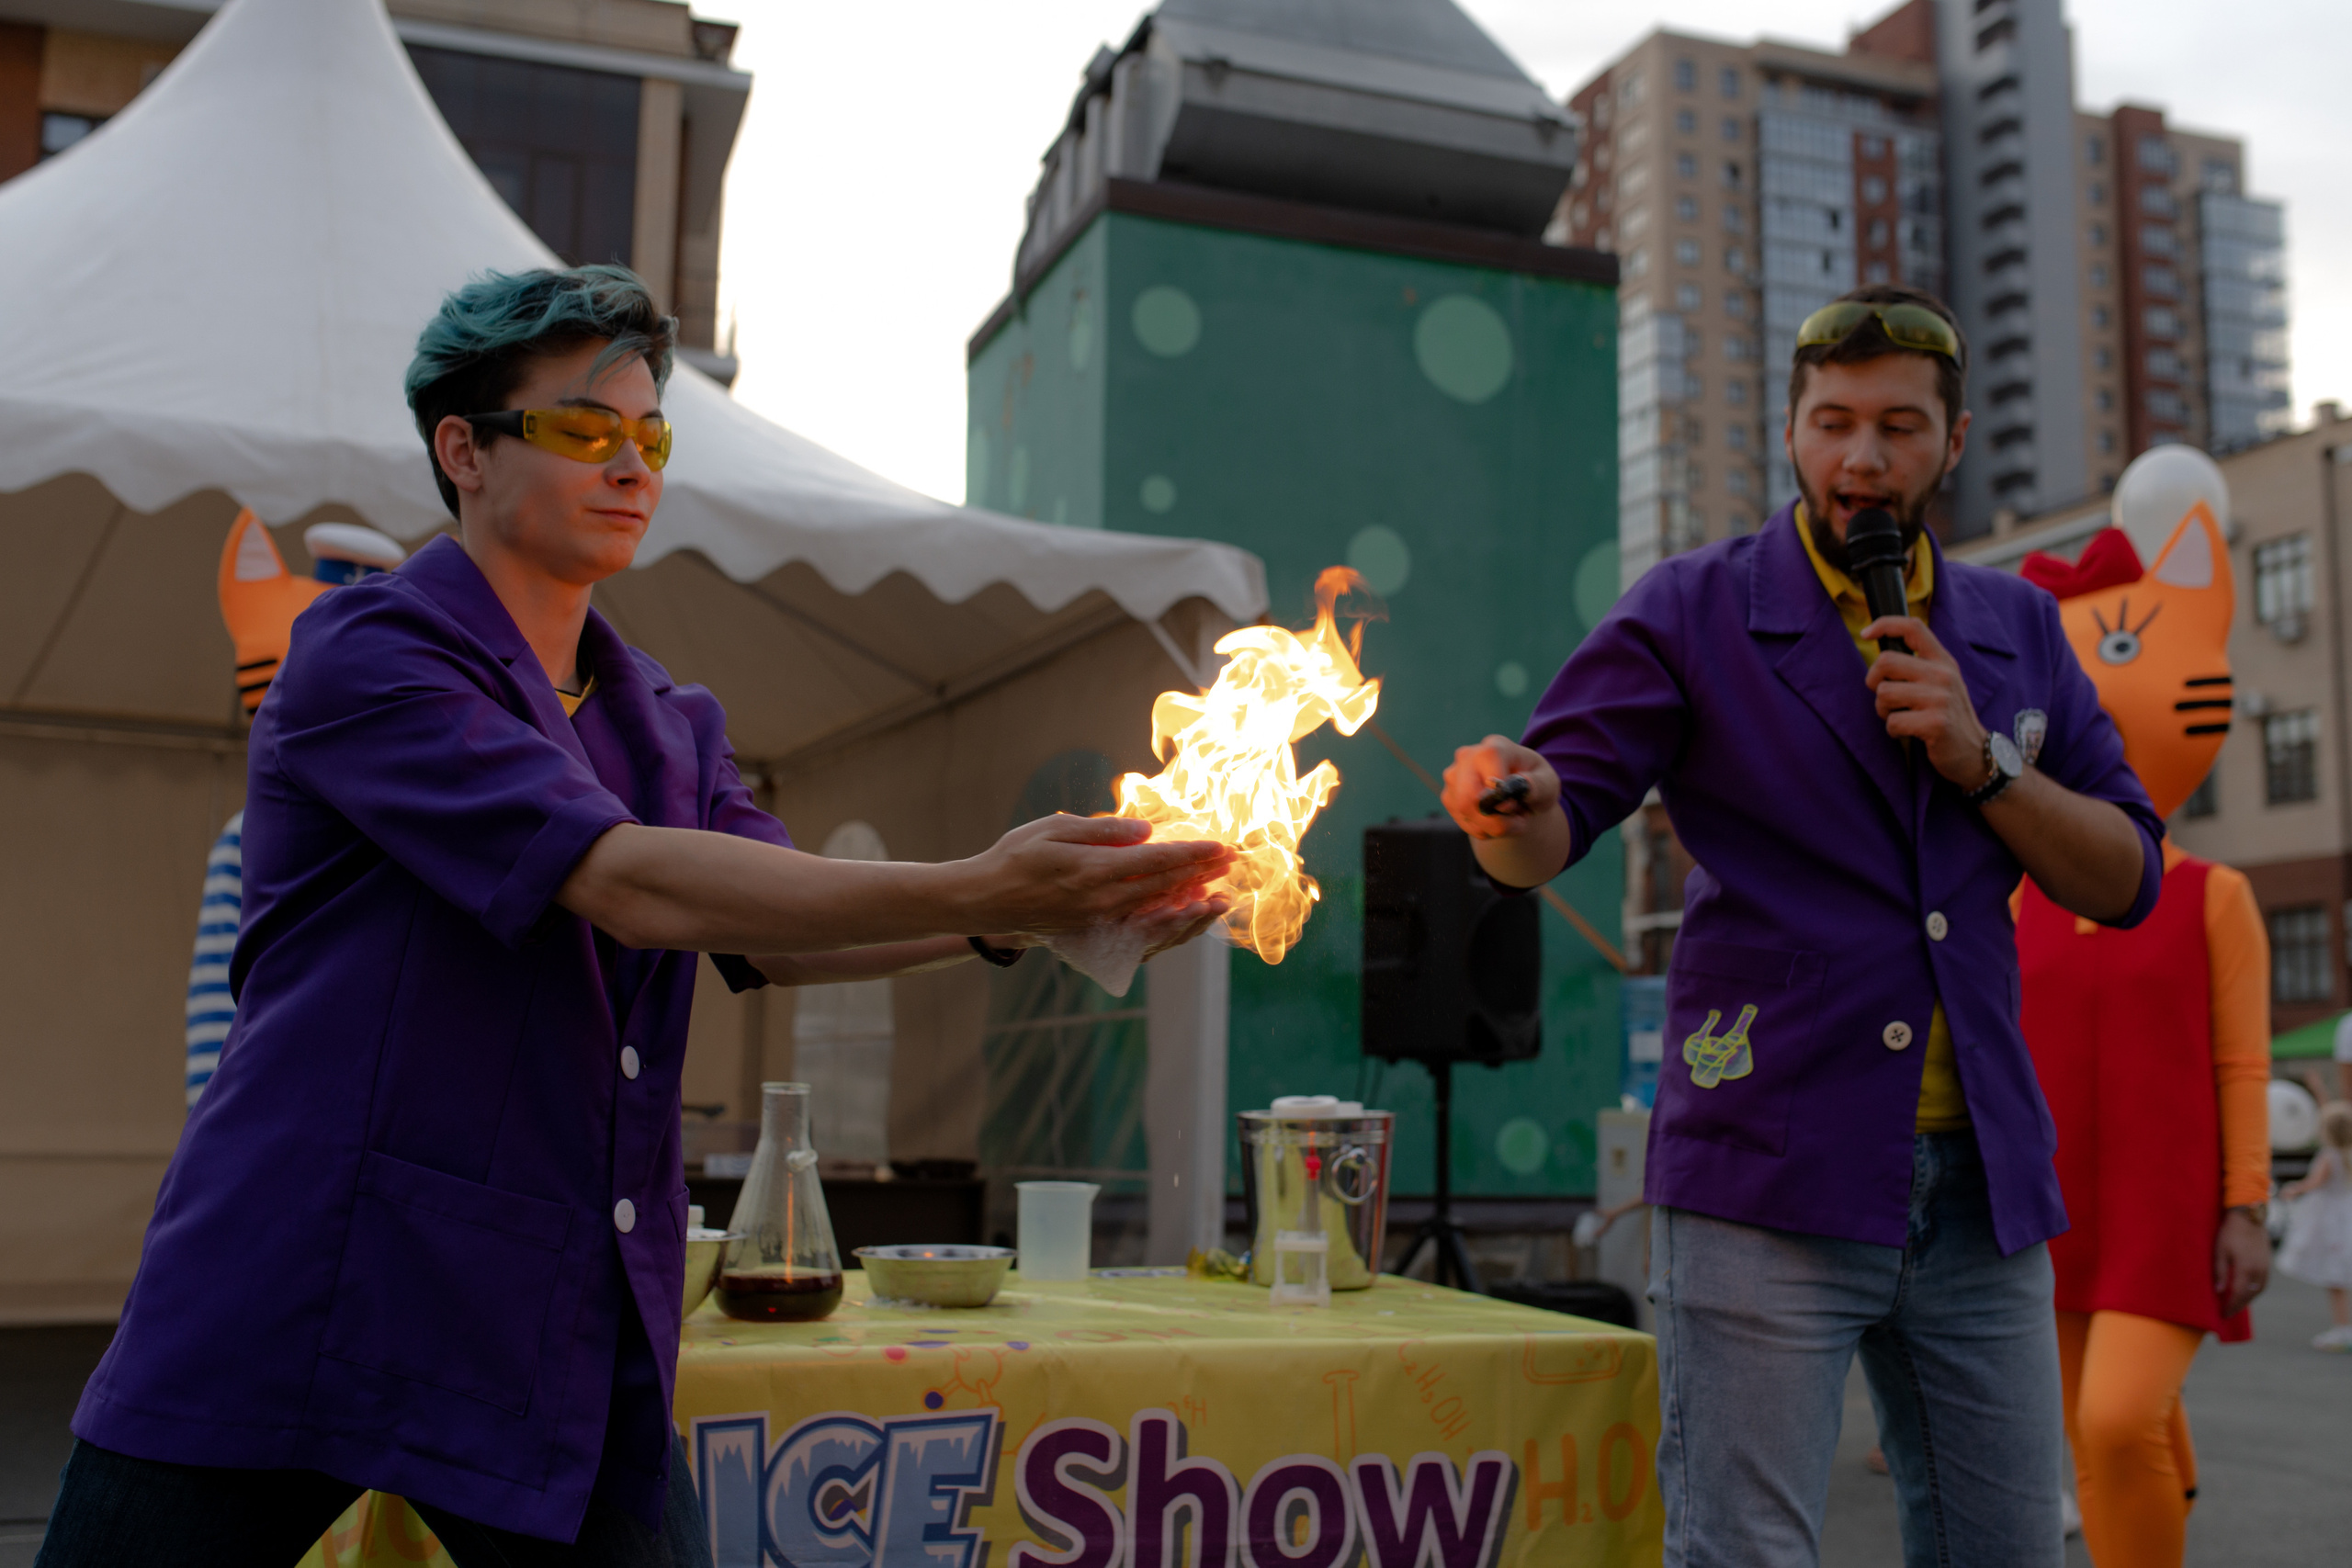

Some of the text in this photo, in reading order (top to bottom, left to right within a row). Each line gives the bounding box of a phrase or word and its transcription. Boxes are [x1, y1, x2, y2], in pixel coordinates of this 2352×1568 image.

[690, 1408, 1512, 1568] ICE Show
[1522, 1421, 1649, 1532] H2O
